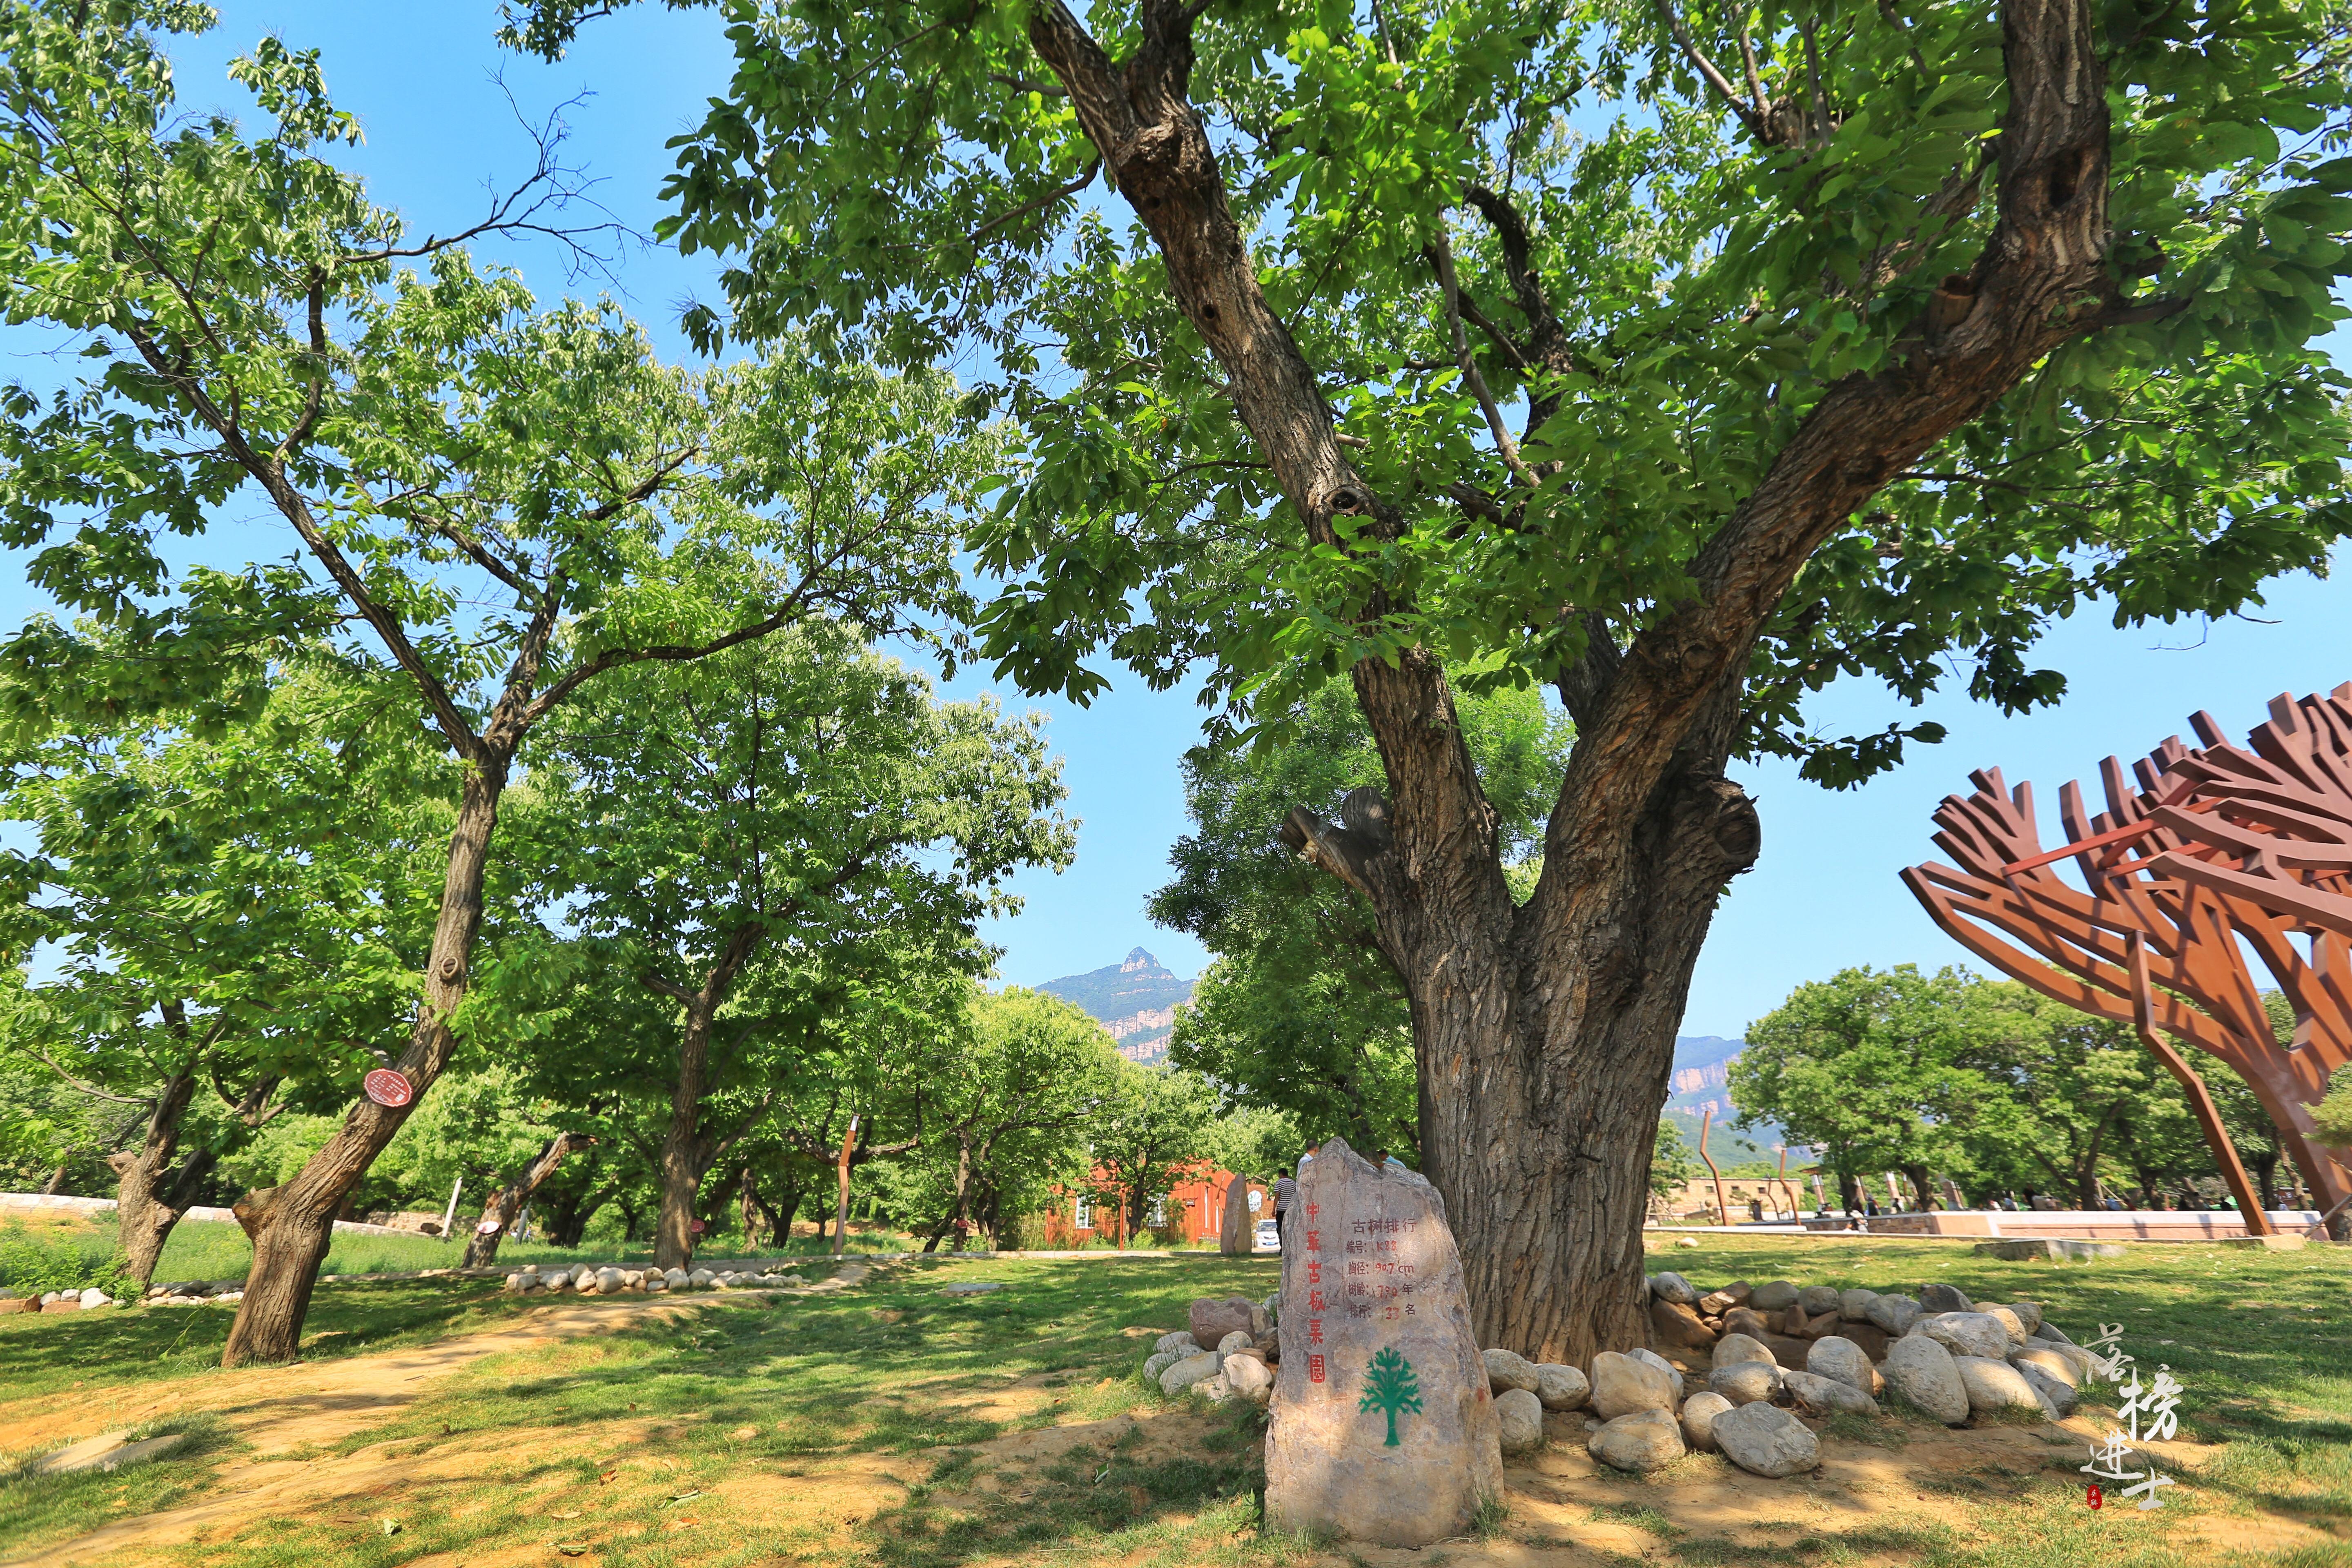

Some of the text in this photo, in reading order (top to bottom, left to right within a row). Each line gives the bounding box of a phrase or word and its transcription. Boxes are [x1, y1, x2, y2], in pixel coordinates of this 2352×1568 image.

[1352, 1218, 1418, 1234] 古树排行
[1398, 1265, 1414, 1273] cm
[1402, 1283, 1413, 1295] 年
[1405, 1303, 1416, 1316] 名
